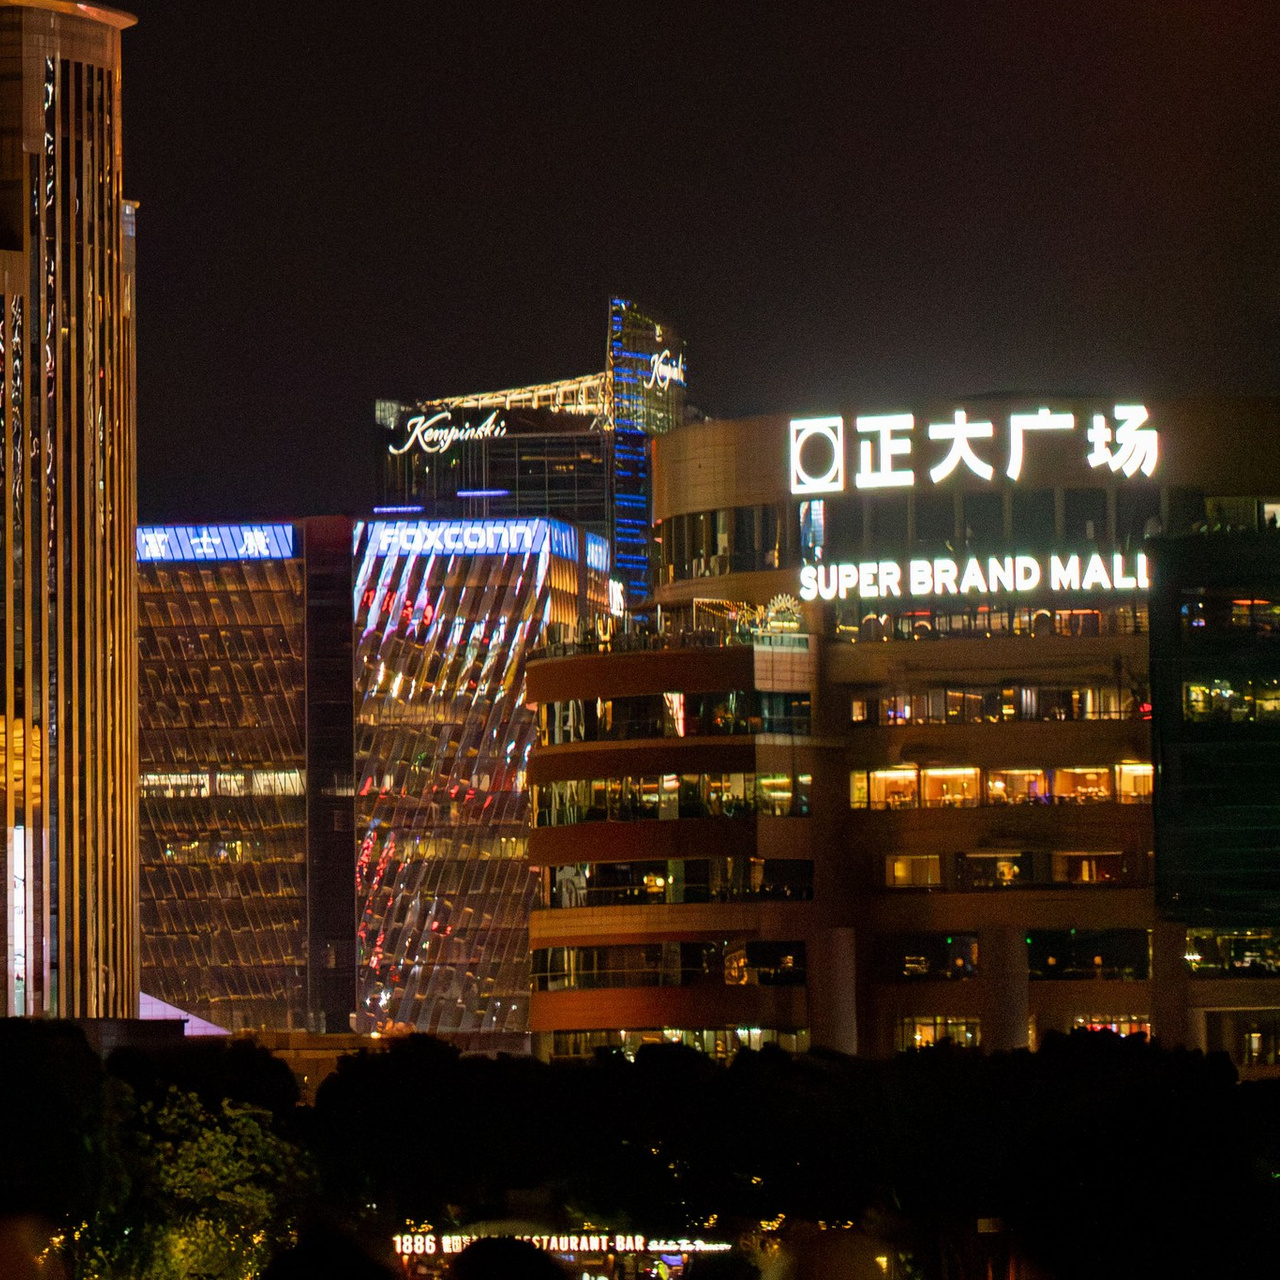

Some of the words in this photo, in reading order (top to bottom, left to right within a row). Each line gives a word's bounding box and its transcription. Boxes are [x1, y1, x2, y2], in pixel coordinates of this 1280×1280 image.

[388, 409, 507, 455] Kempinski
[855, 404, 1159, 489] 正大广场
[141, 528, 270, 558] 富士康
[799, 559, 902, 602] SUPER
[909, 555, 1041, 596] BRAND
[1050, 550, 1150, 591] MALL
